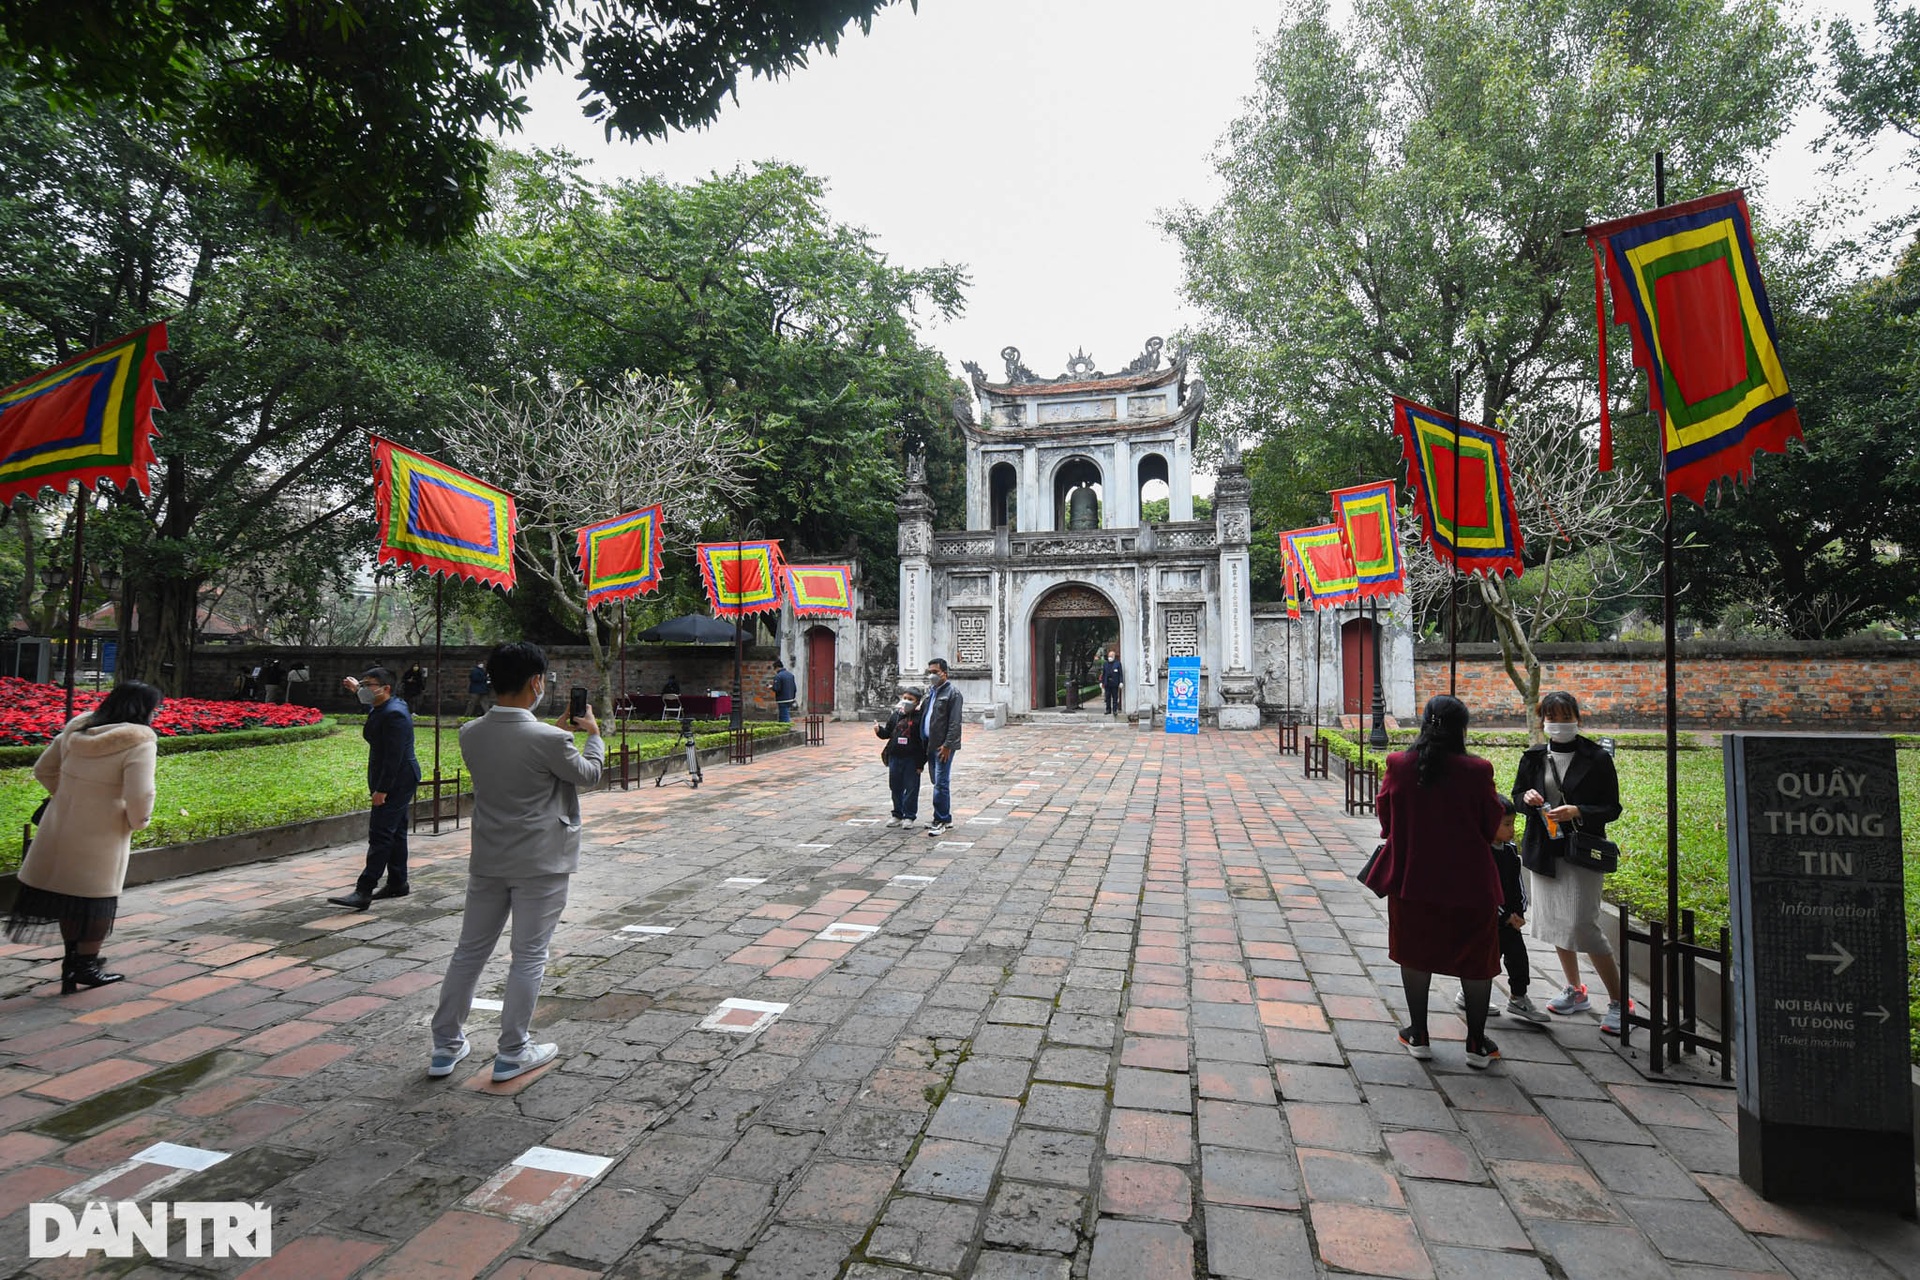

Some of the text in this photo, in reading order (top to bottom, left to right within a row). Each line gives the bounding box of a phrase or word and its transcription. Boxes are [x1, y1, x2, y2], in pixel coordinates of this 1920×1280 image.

[1777, 766, 1867, 799] QUẦY
[1763, 807, 1884, 837] THÔNG
[1798, 851, 1853, 876] TIN
[1780, 901, 1877, 918] Information
[1774, 998, 1800, 1011] NƠI
[1779, 1034, 1856, 1050] Ticket machine
